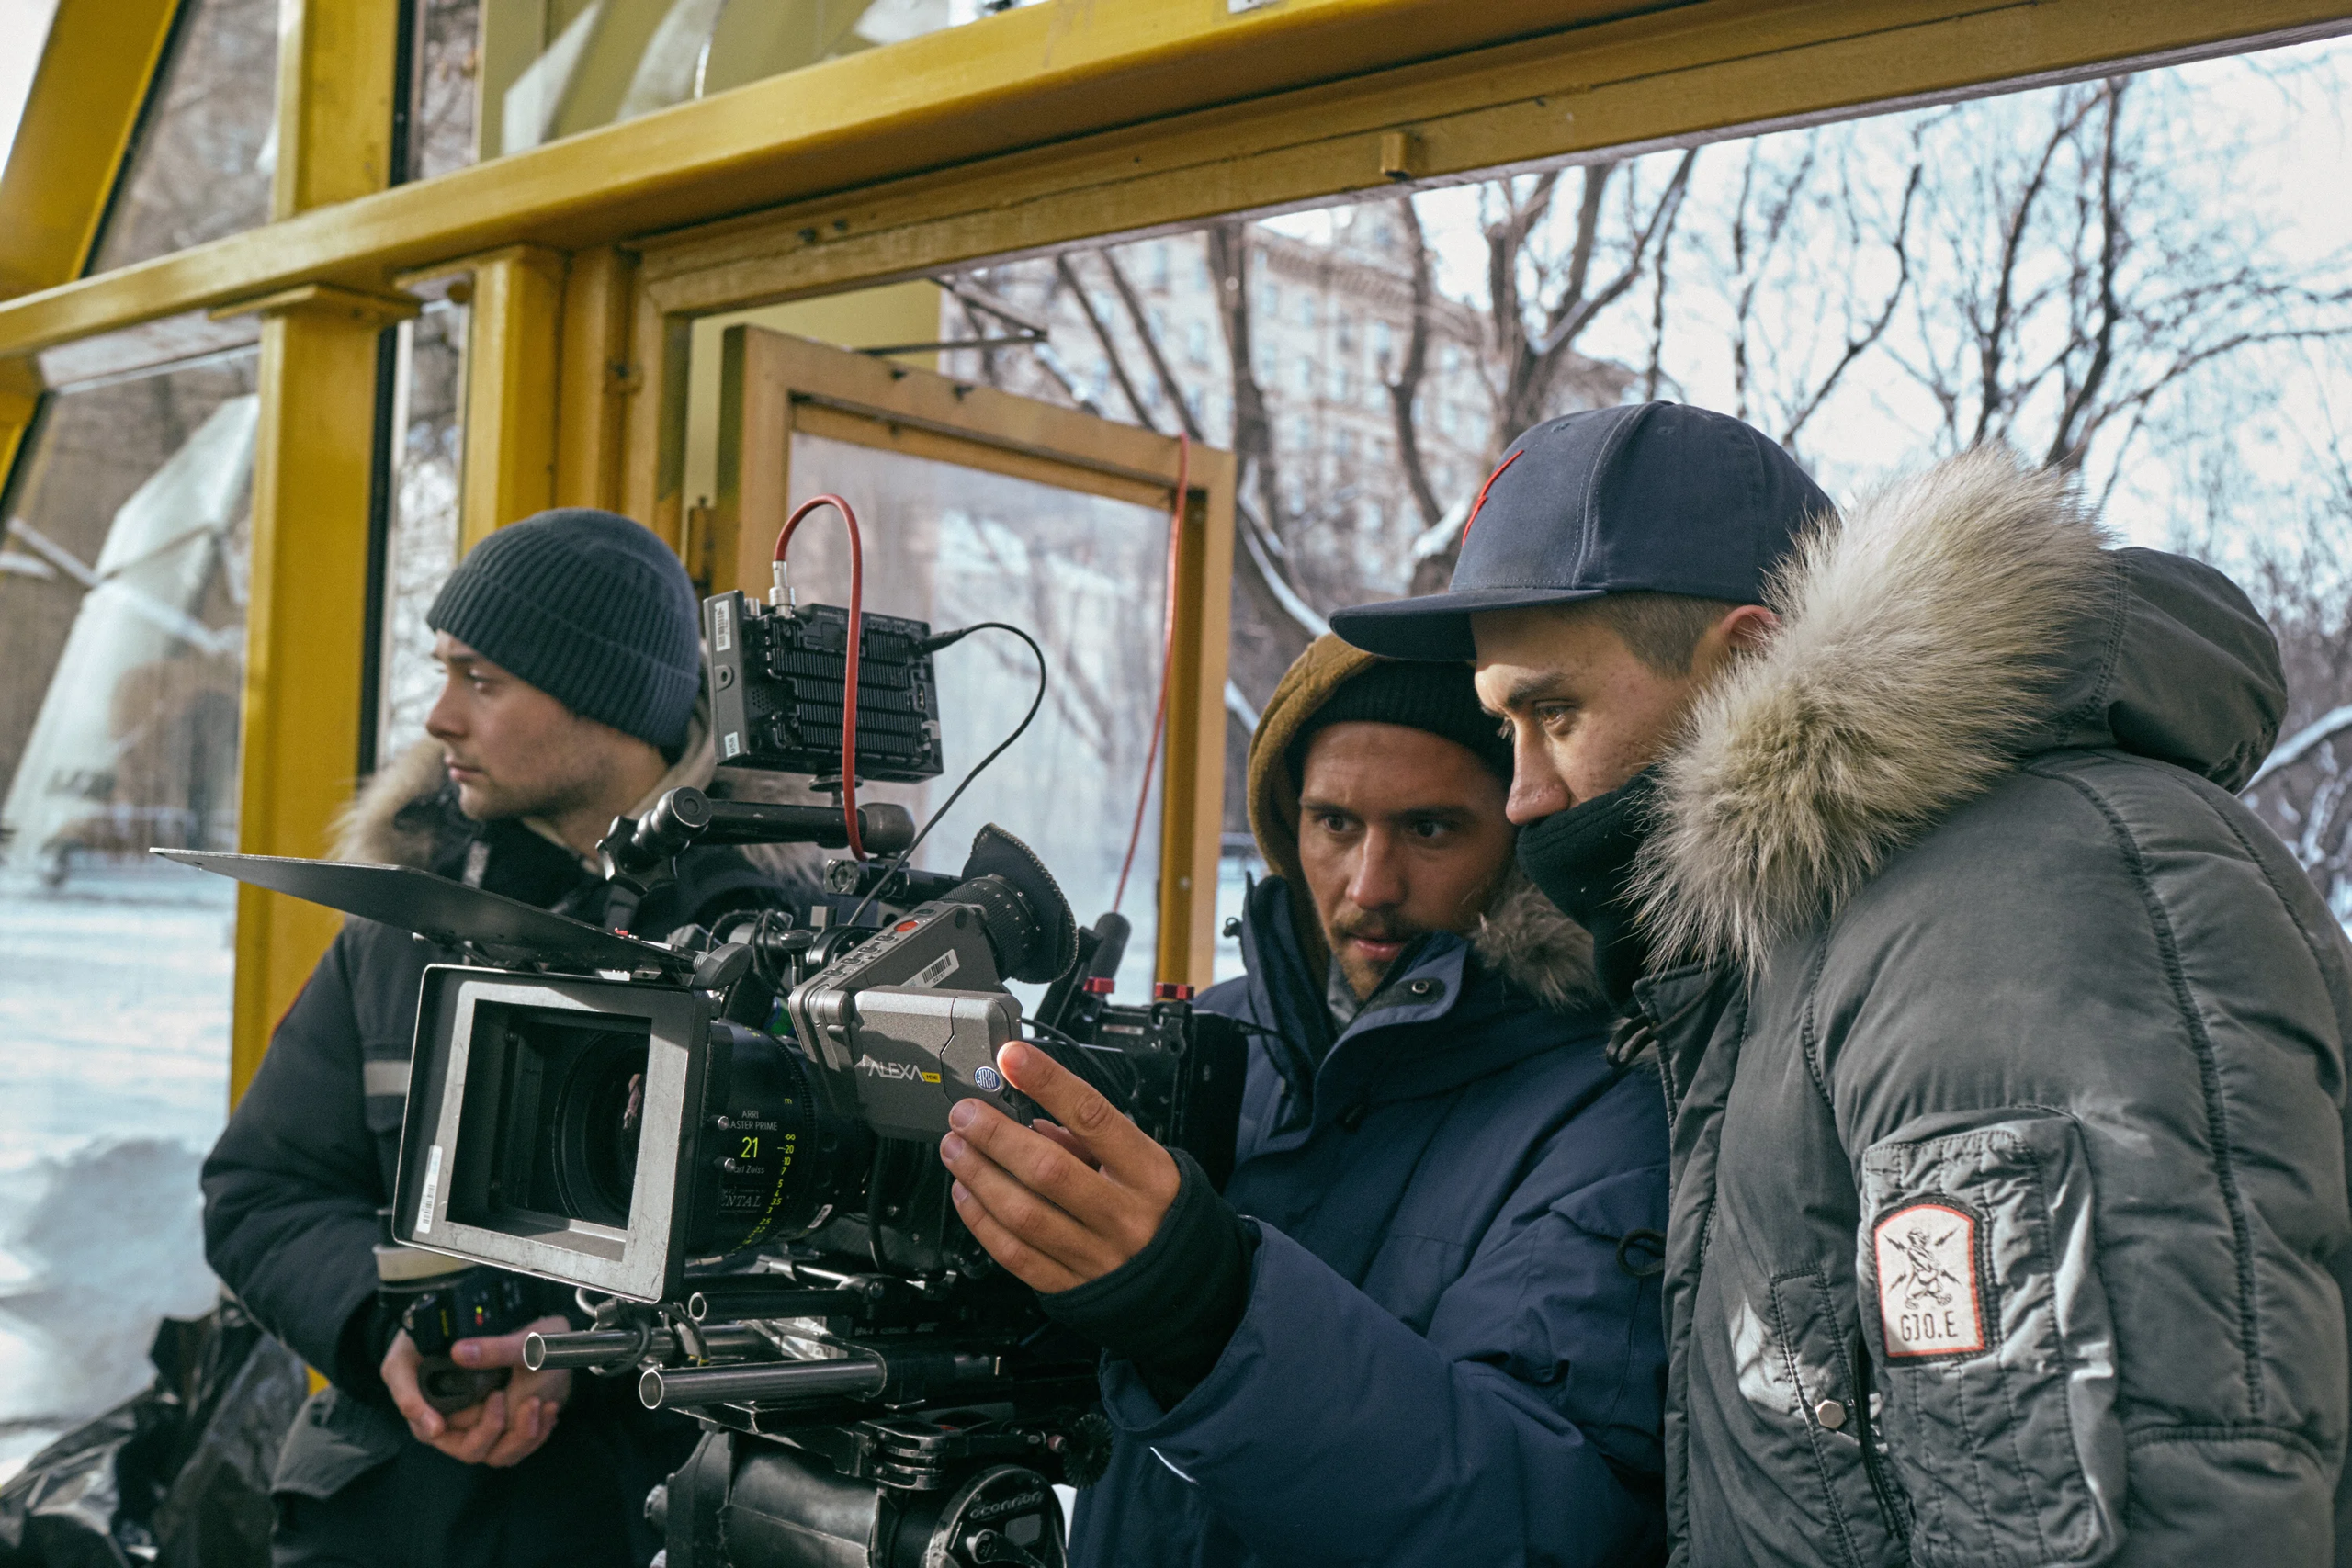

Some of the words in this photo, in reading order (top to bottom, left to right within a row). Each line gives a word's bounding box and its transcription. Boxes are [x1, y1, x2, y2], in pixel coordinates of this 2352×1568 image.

[868, 1060, 925, 1083] ALEXA
[978, 1068, 997, 1089] ARRI
[741, 1110, 759, 1119] ARRI
[755, 1122, 777, 1130] PRIME
[741, 1136, 758, 1157] 21
[733, 1165, 744, 1173] arl
[746, 1165, 764, 1173] Zeiss
